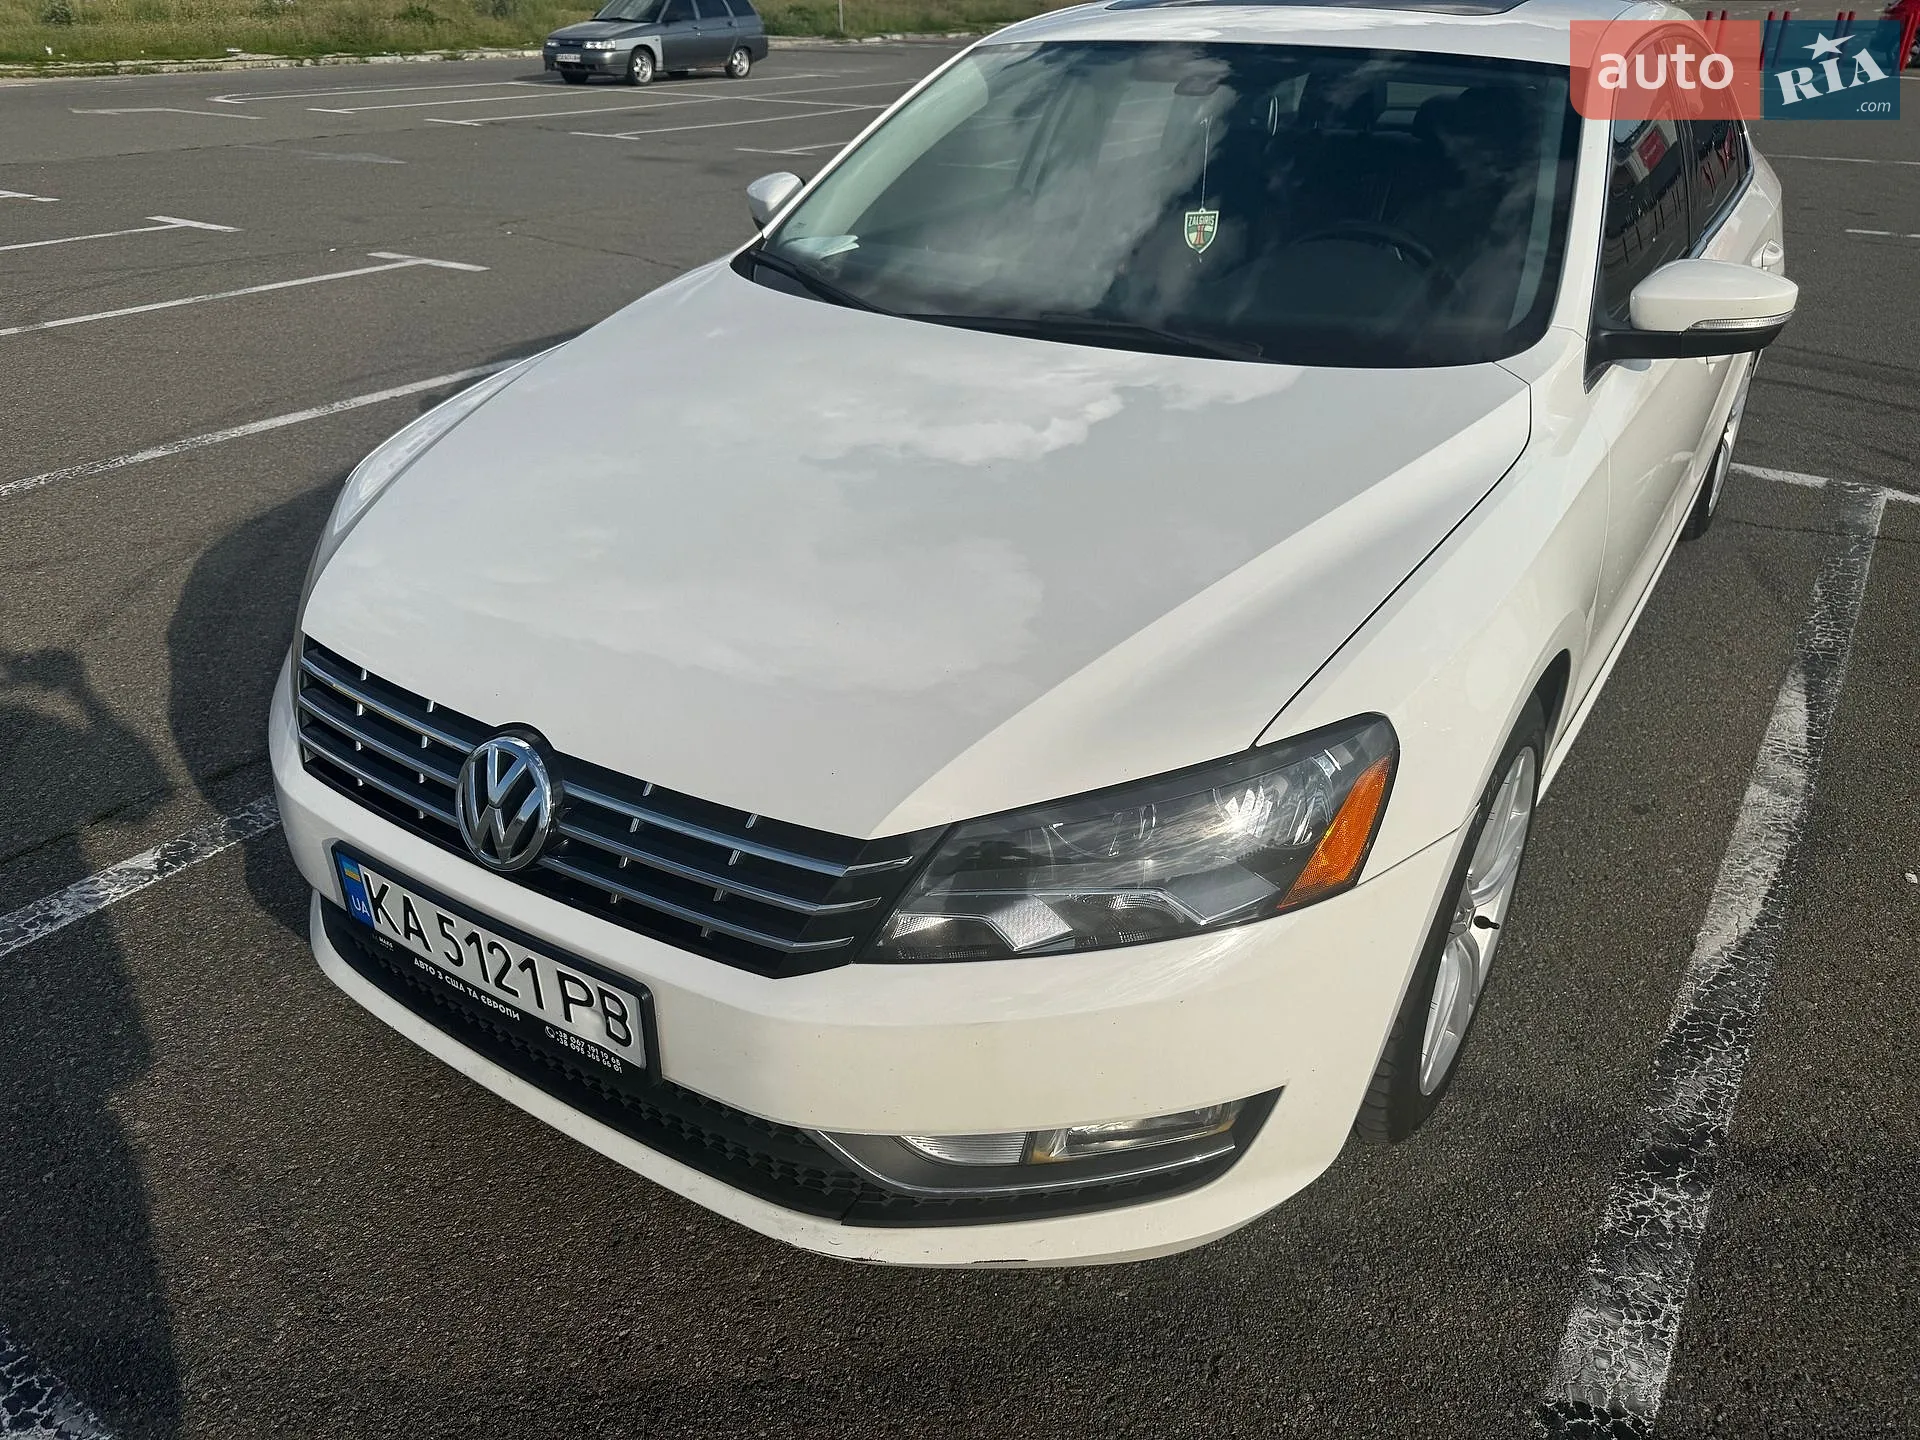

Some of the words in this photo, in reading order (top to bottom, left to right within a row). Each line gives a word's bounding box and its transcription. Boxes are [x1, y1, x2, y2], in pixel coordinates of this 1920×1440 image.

[351, 895, 371, 917] UA
[363, 871, 433, 953] KA
[436, 911, 546, 1010] 5121
[556, 967, 634, 1047] PB
[414, 957, 436, 976] АВТО
[445, 975, 466, 993] США
[466, 986, 479, 1000] ТА
[480, 995, 520, 1021] ЄВРОПИ
